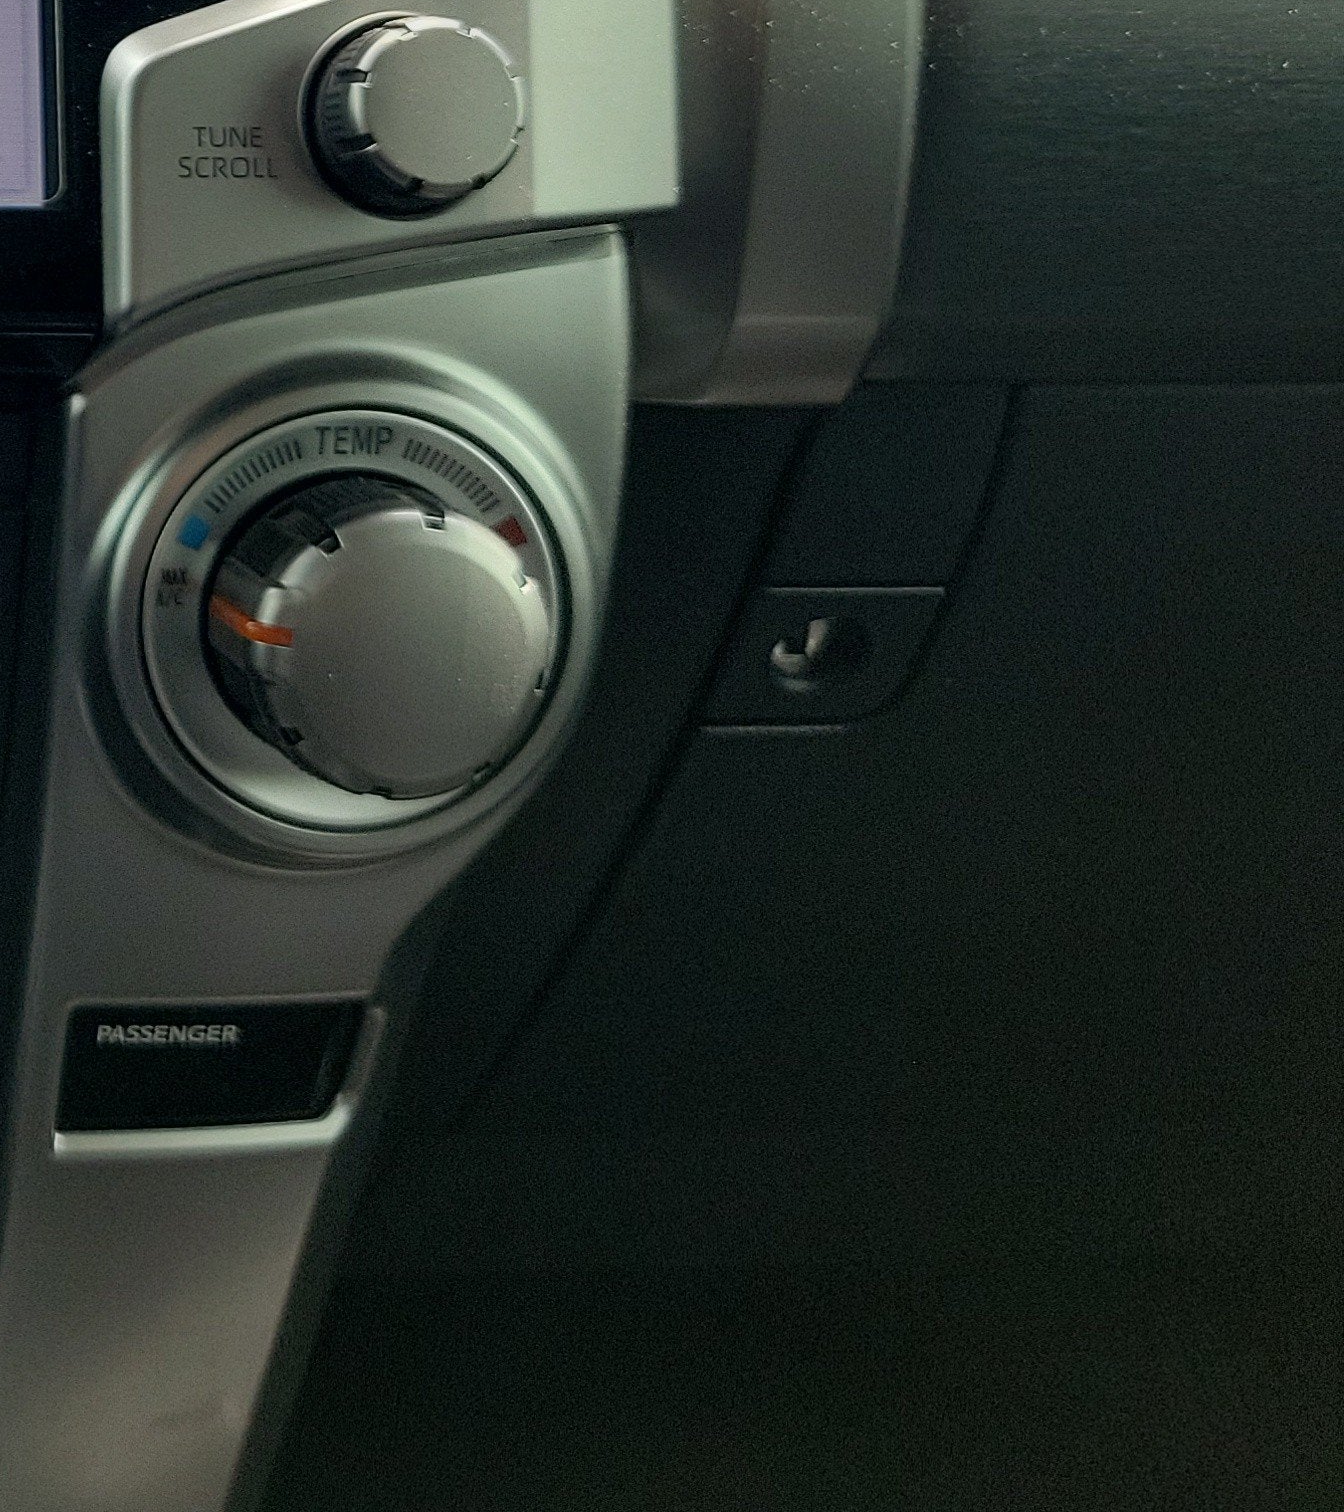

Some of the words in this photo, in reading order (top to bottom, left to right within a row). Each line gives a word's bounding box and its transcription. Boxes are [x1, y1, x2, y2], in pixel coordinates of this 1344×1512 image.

[193, 126, 262, 149] TUNE
[178, 155, 278, 179] SCROLL
[314, 426, 395, 456] TEMP
[97, 1024, 238, 1045] PASSENGER
